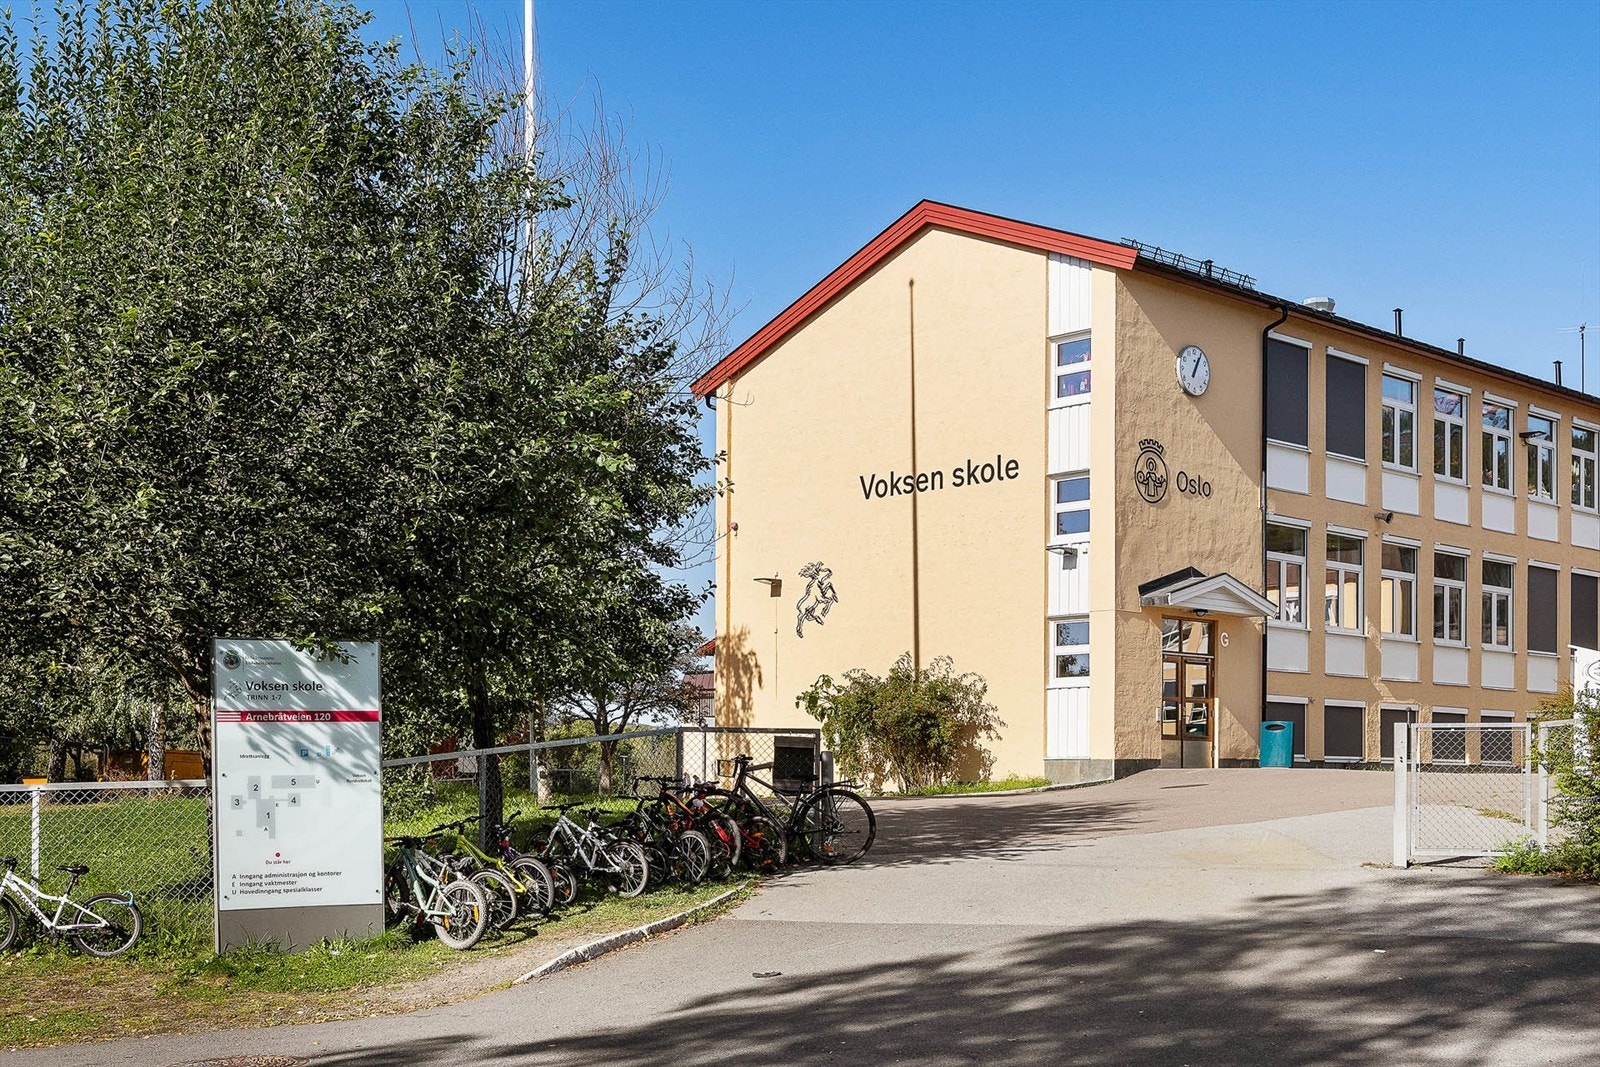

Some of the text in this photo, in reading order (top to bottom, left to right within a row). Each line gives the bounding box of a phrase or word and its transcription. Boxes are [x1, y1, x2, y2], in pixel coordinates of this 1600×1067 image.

[859, 454, 1019, 500] Voksen skole
[1176, 471, 1211, 497] Oslo
[1220, 632, 1229, 647] G
[246, 681, 323, 692] Voksen skole
[246, 713, 331, 721] Arnebråtveien 120
[290, 778, 297, 786] 5
[253, 784, 259, 792] 2
[234, 798, 240, 806] 3
[290, 796, 297, 804] 4
[265, 811, 271, 819] 1
[283, 886, 322, 894] spesialklasser
